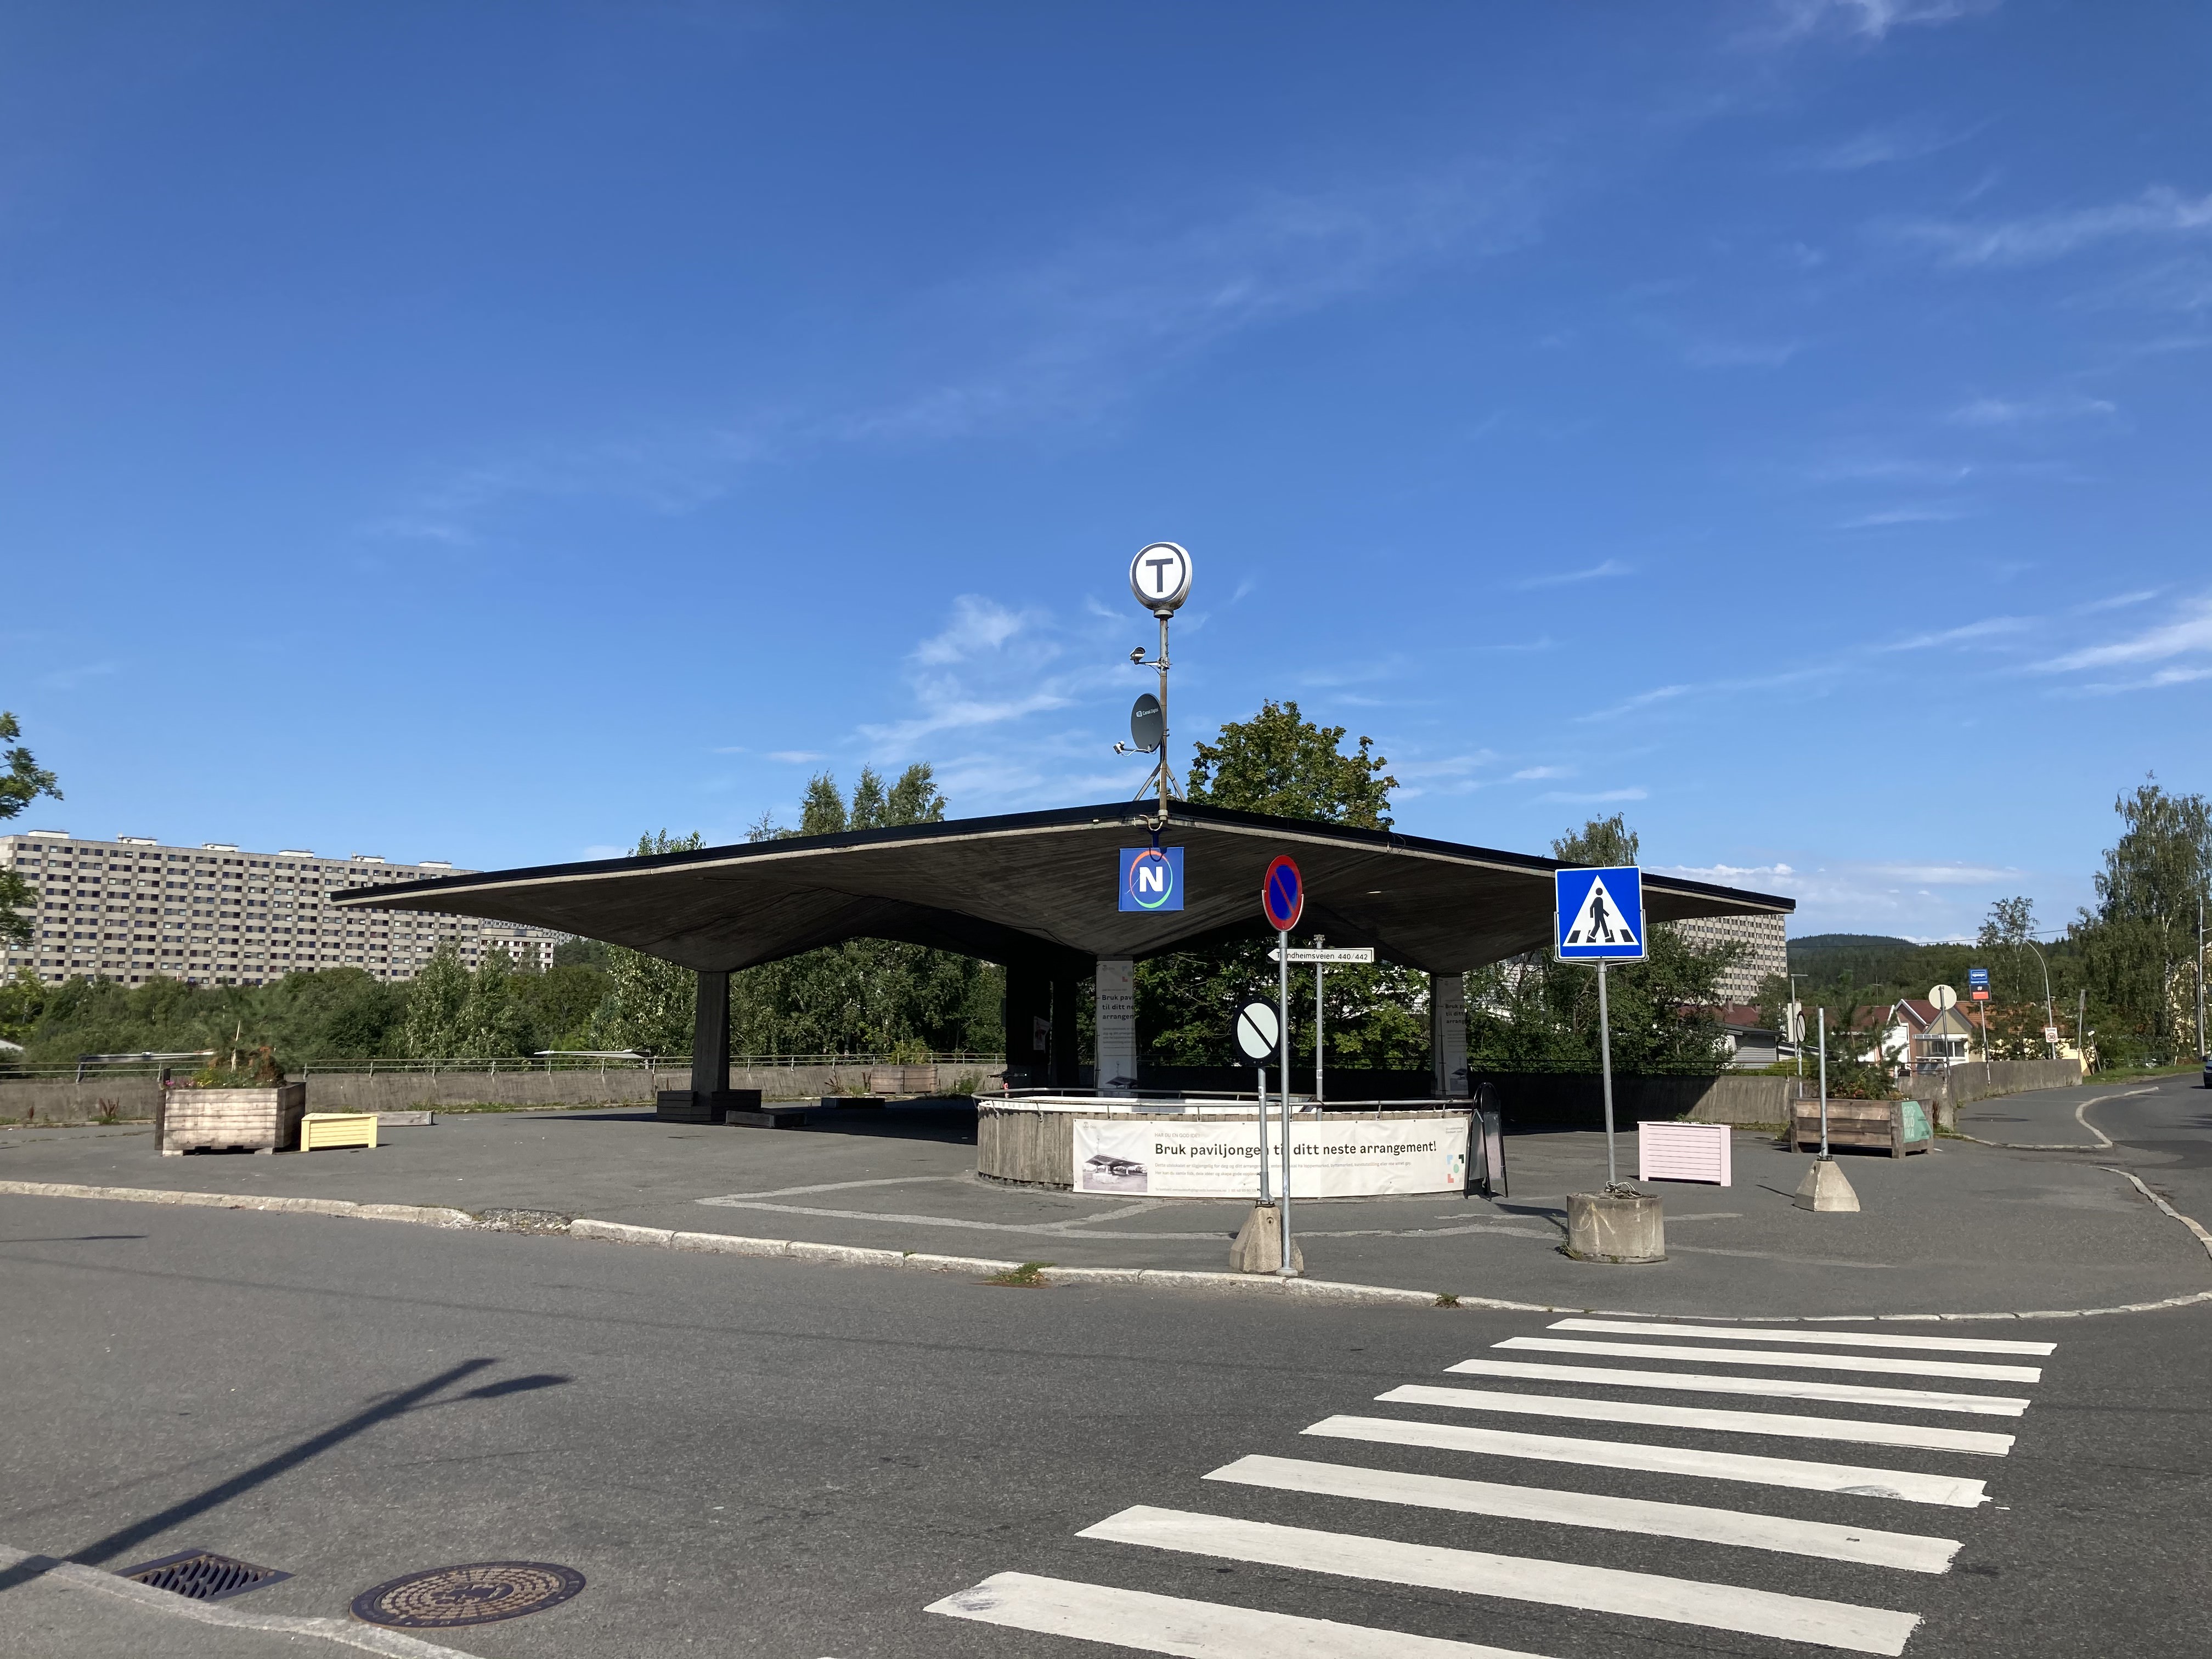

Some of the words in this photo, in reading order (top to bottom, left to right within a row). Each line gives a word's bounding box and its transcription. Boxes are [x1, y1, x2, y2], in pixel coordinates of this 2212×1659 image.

[1146, 558, 1173, 592] T
[1139, 866, 1163, 892] N
[1155, 1143, 1186, 1154] Bruk
[1294, 1143, 1319, 1155] ditt
[1323, 1144, 1356, 1155] neste
[1360, 1141, 1437, 1156] arrangement!
